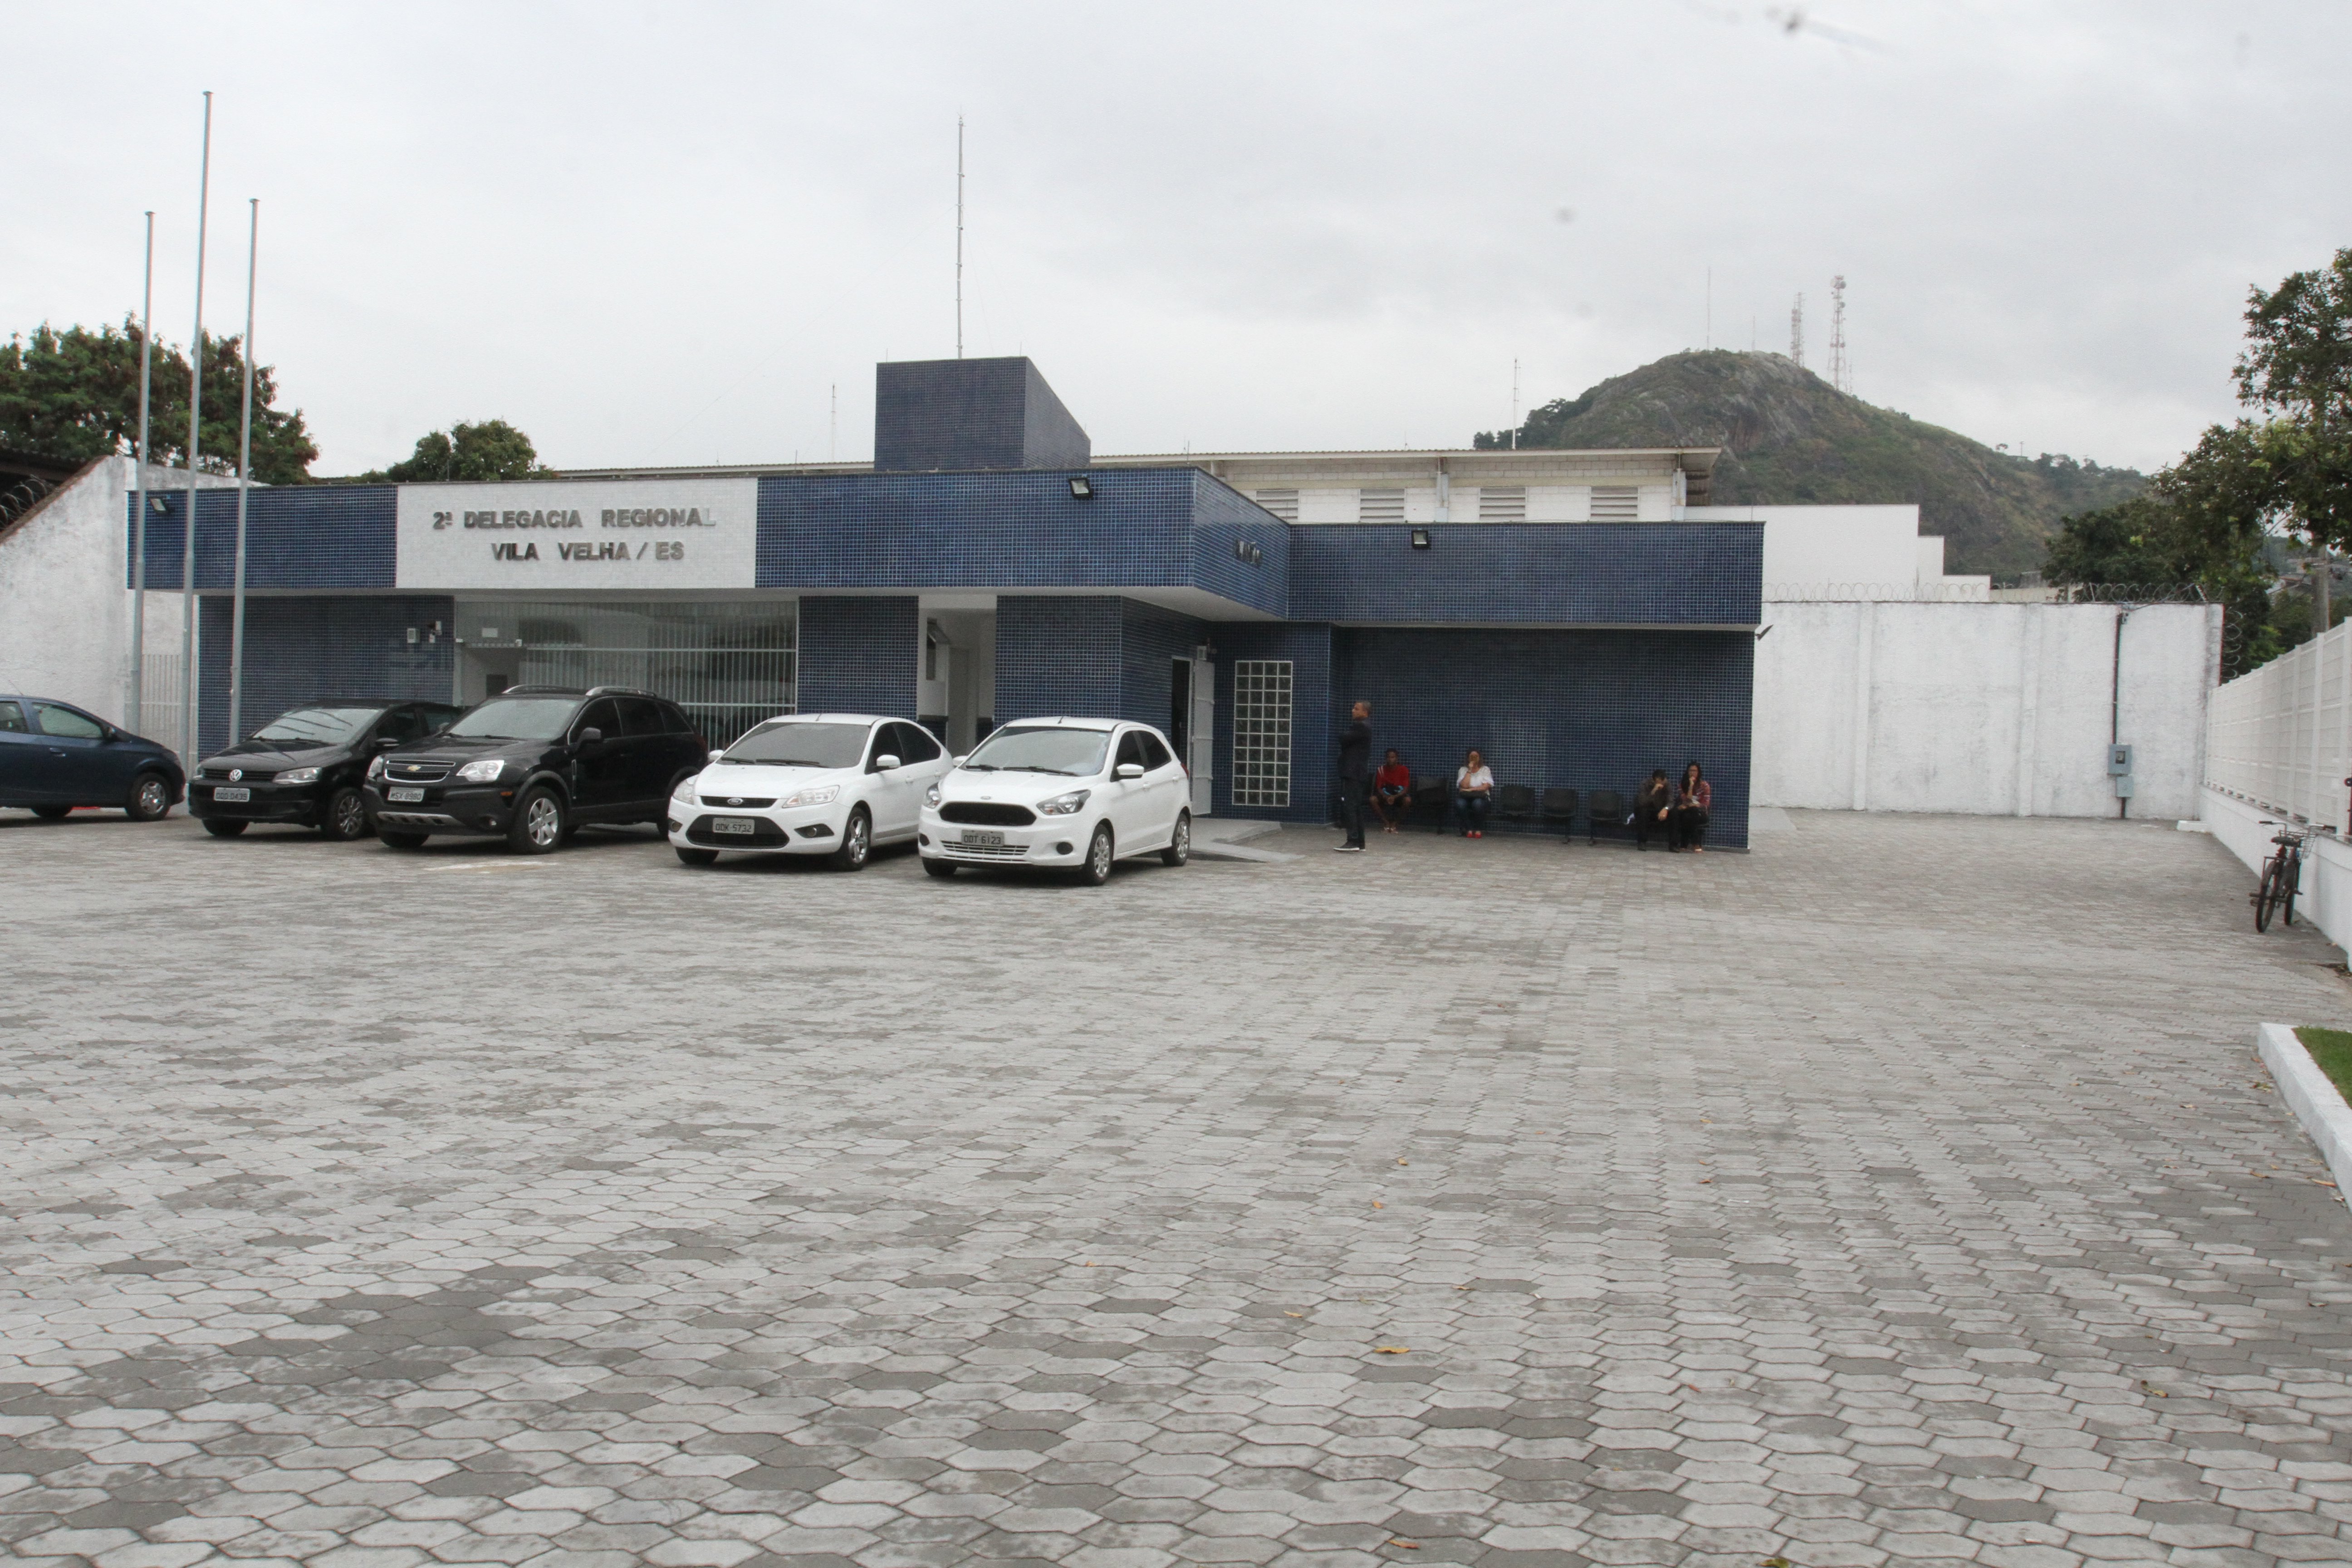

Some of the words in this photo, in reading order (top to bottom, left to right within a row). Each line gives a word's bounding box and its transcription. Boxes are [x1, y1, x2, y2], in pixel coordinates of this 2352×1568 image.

[464, 510, 583, 529] DELEGACIA
[601, 508, 716, 527] REGIONAL
[491, 542, 540, 561] VILA
